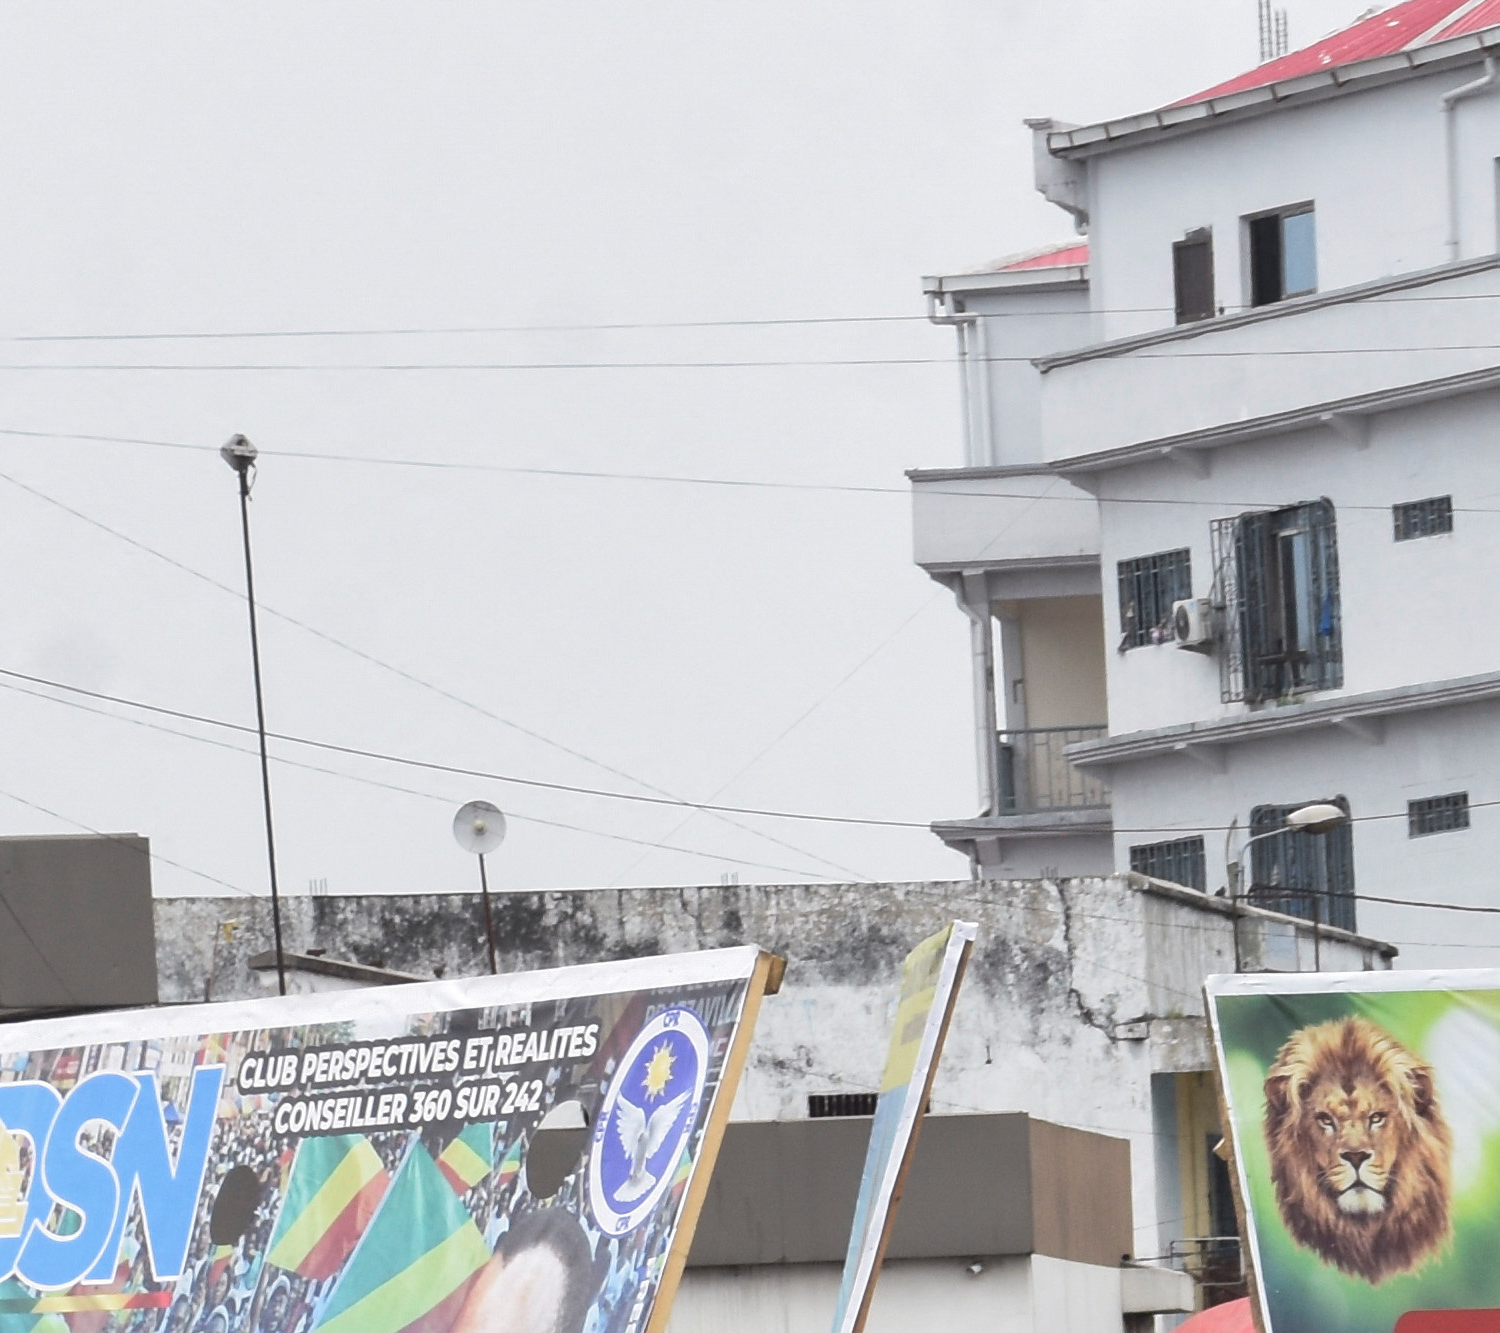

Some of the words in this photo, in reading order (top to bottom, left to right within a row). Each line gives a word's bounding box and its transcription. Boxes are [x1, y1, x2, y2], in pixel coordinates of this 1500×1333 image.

[239, 1053, 297, 1089] CLUB
[301, 1040, 460, 1085] PERSPECTIVES
[463, 1036, 493, 1070] ET
[494, 1023, 599, 1066] REALITES
[274, 1097, 406, 1135] CONSEILLER
[410, 1091, 450, 1123] 360
[454, 1087, 499, 1119] SUR
[503, 1079, 542, 1114] 242
